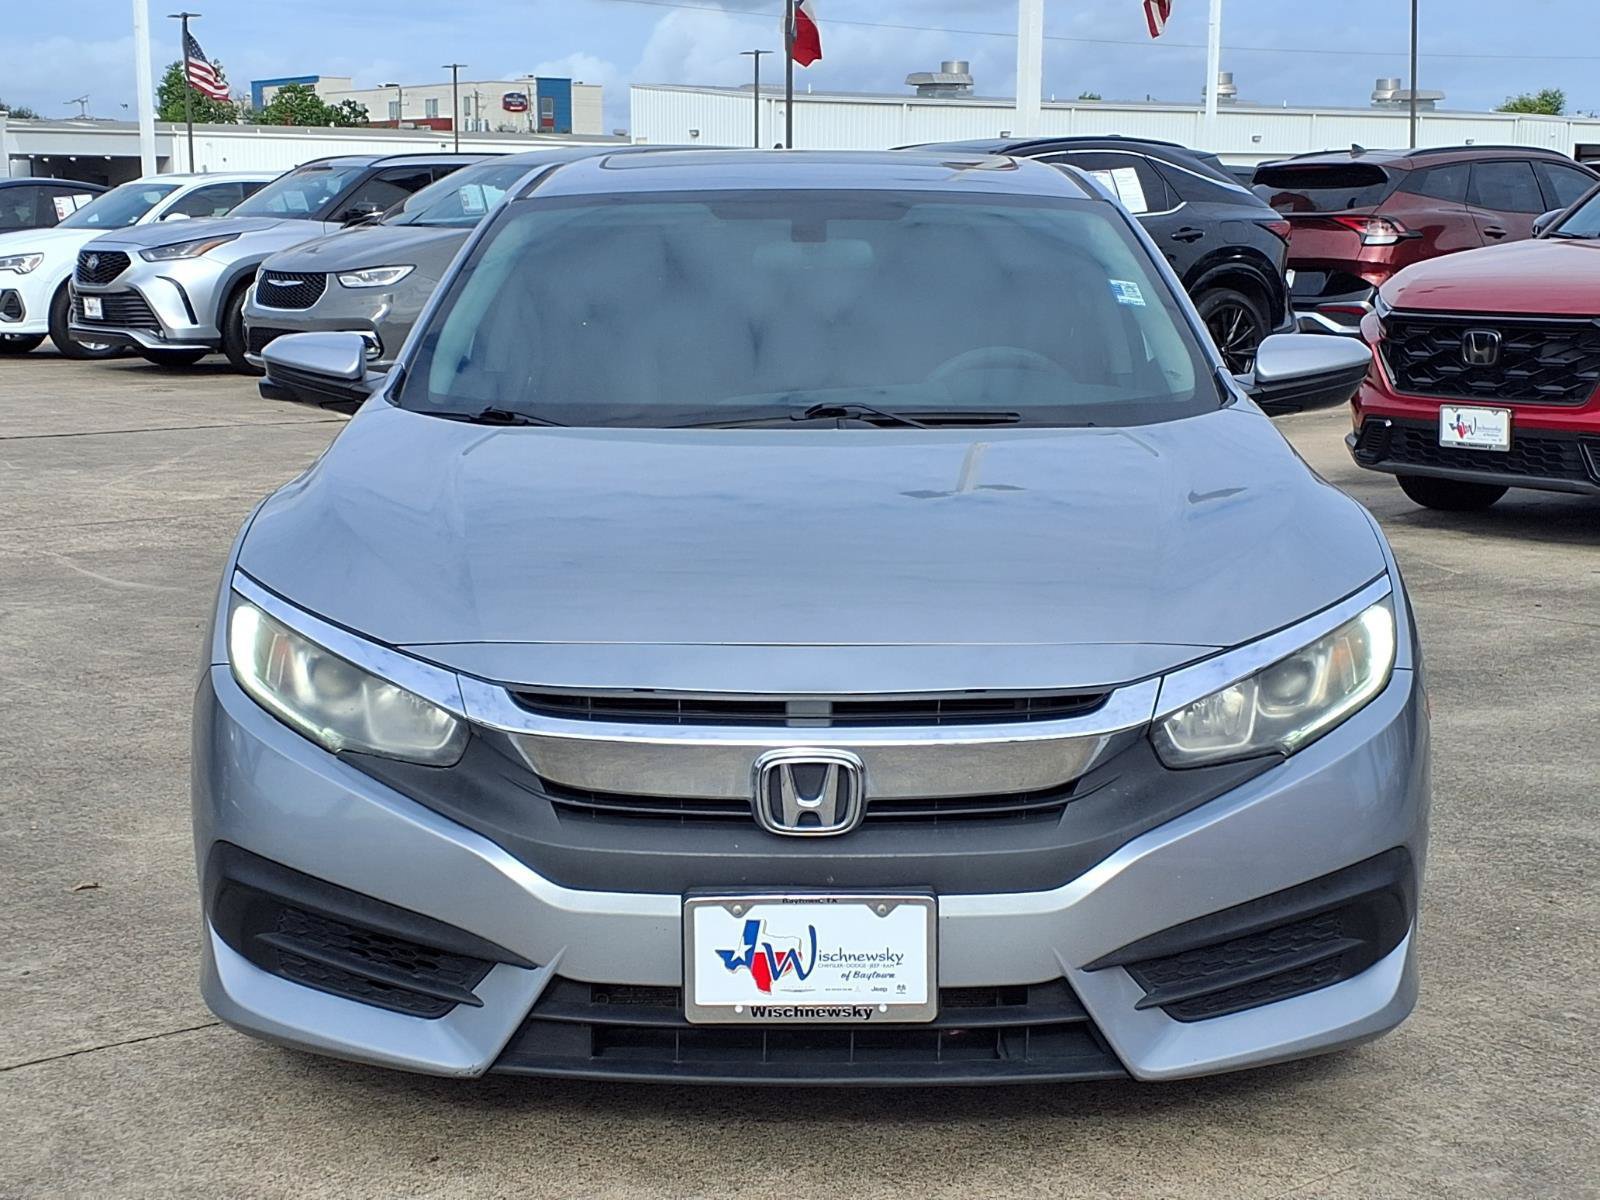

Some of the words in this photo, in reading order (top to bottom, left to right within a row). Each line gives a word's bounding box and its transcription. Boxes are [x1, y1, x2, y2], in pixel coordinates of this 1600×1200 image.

[841, 970, 852, 981] of
[852, 970, 896, 981] Baytown
[750, 1005, 873, 1020] Wischnewsky
